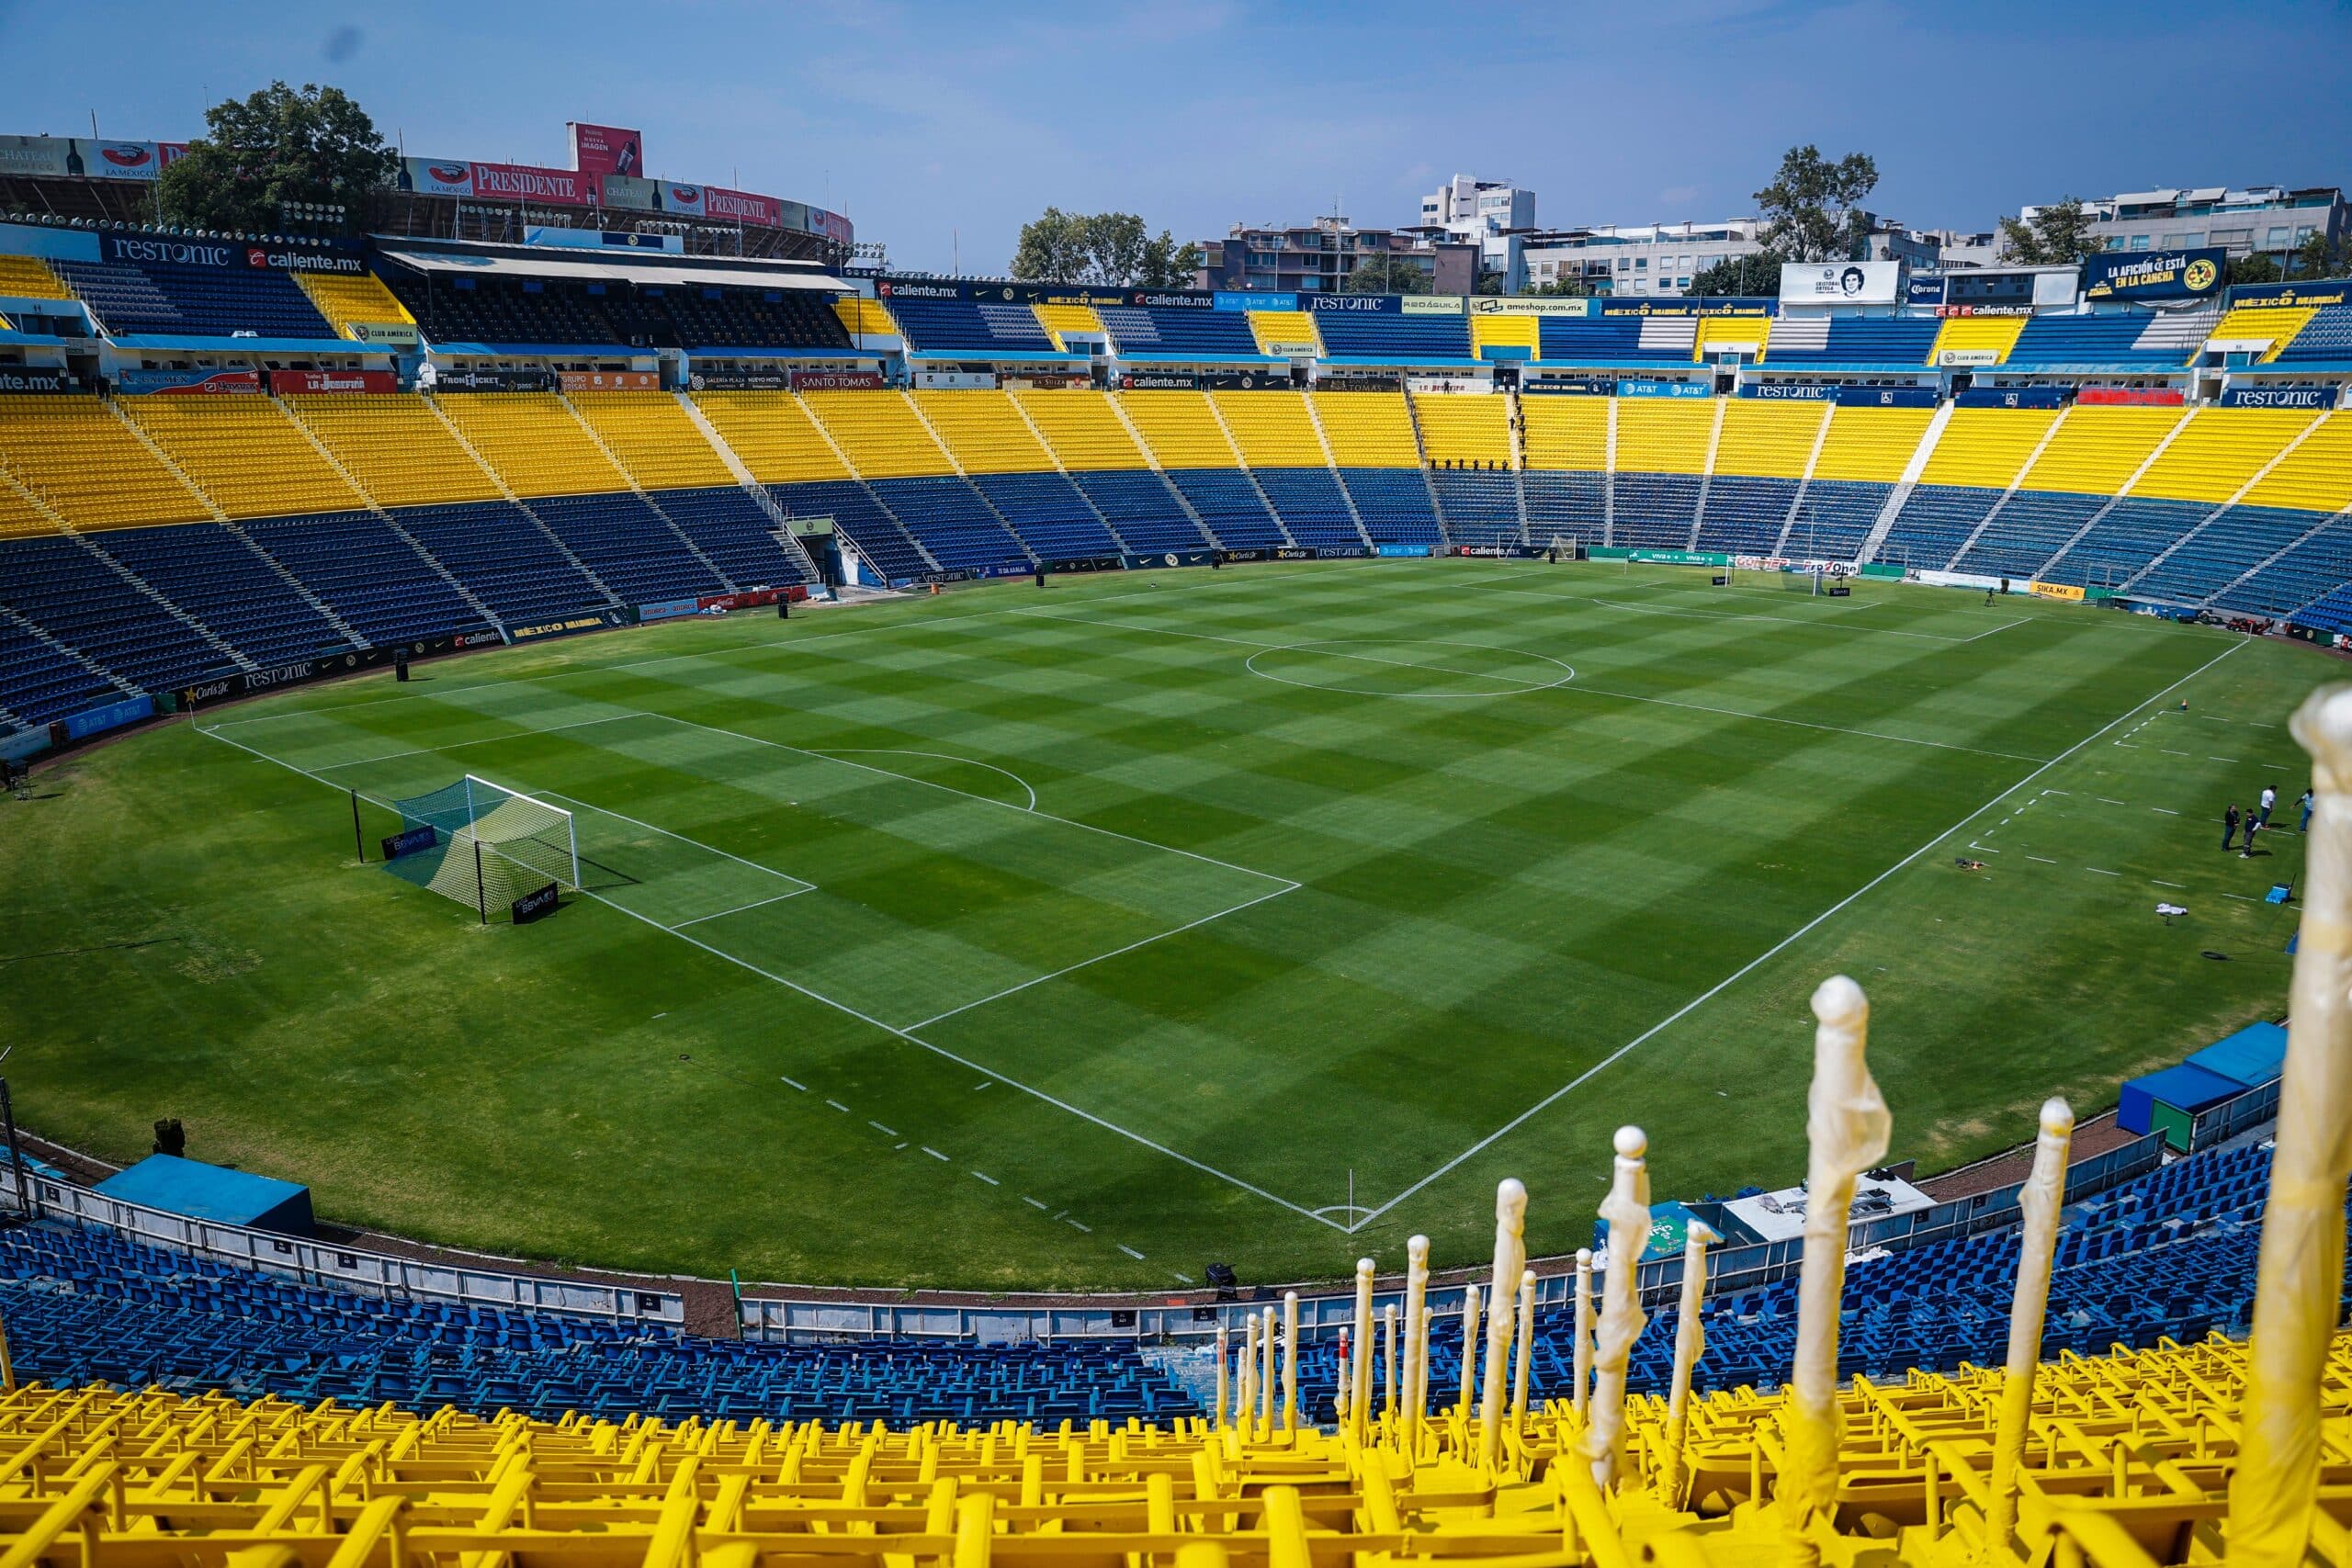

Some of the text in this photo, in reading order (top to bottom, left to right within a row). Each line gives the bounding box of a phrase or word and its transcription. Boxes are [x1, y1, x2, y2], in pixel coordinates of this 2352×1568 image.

[581, 141, 608, 152] IMAGEN
[476, 165, 576, 198] PRESIDENTE
[707, 189, 766, 220] PRESIDENTE
[266, 251, 361, 272] caliente.mx
[2108, 254, 2186, 277] LA AFICIÓN ESTÁ
[2115, 271, 2175, 288] EN LA CANCHA
[891, 283, 957, 299] caliente.mx
[1911, 284, 1940, 295] Corona
[1145, 293, 1213, 307] caliente.mx
[1507, 302, 1582, 312] ameshop.com.mx
[1972, 305, 2033, 316] caliente.mx
[387, 328, 413, 338] AMÉRICA
[562, 375, 587, 383] GRUPO
[801, 378, 836, 387] SANTO
[1133, 376, 1193, 389] caliente.mx
[1636, 385, 1657, 393] AT&T
[1682, 386, 1703, 395] AT&T
[1470, 546, 1521, 556] caliente.mx
[2037, 584, 2068, 595] SIKA.MX
[513, 622, 564, 637] MÉXICO
[464, 630, 501, 646] caliente
[196, 684, 218, 701] Carl's
[523, 896, 545, 914] BBVA
